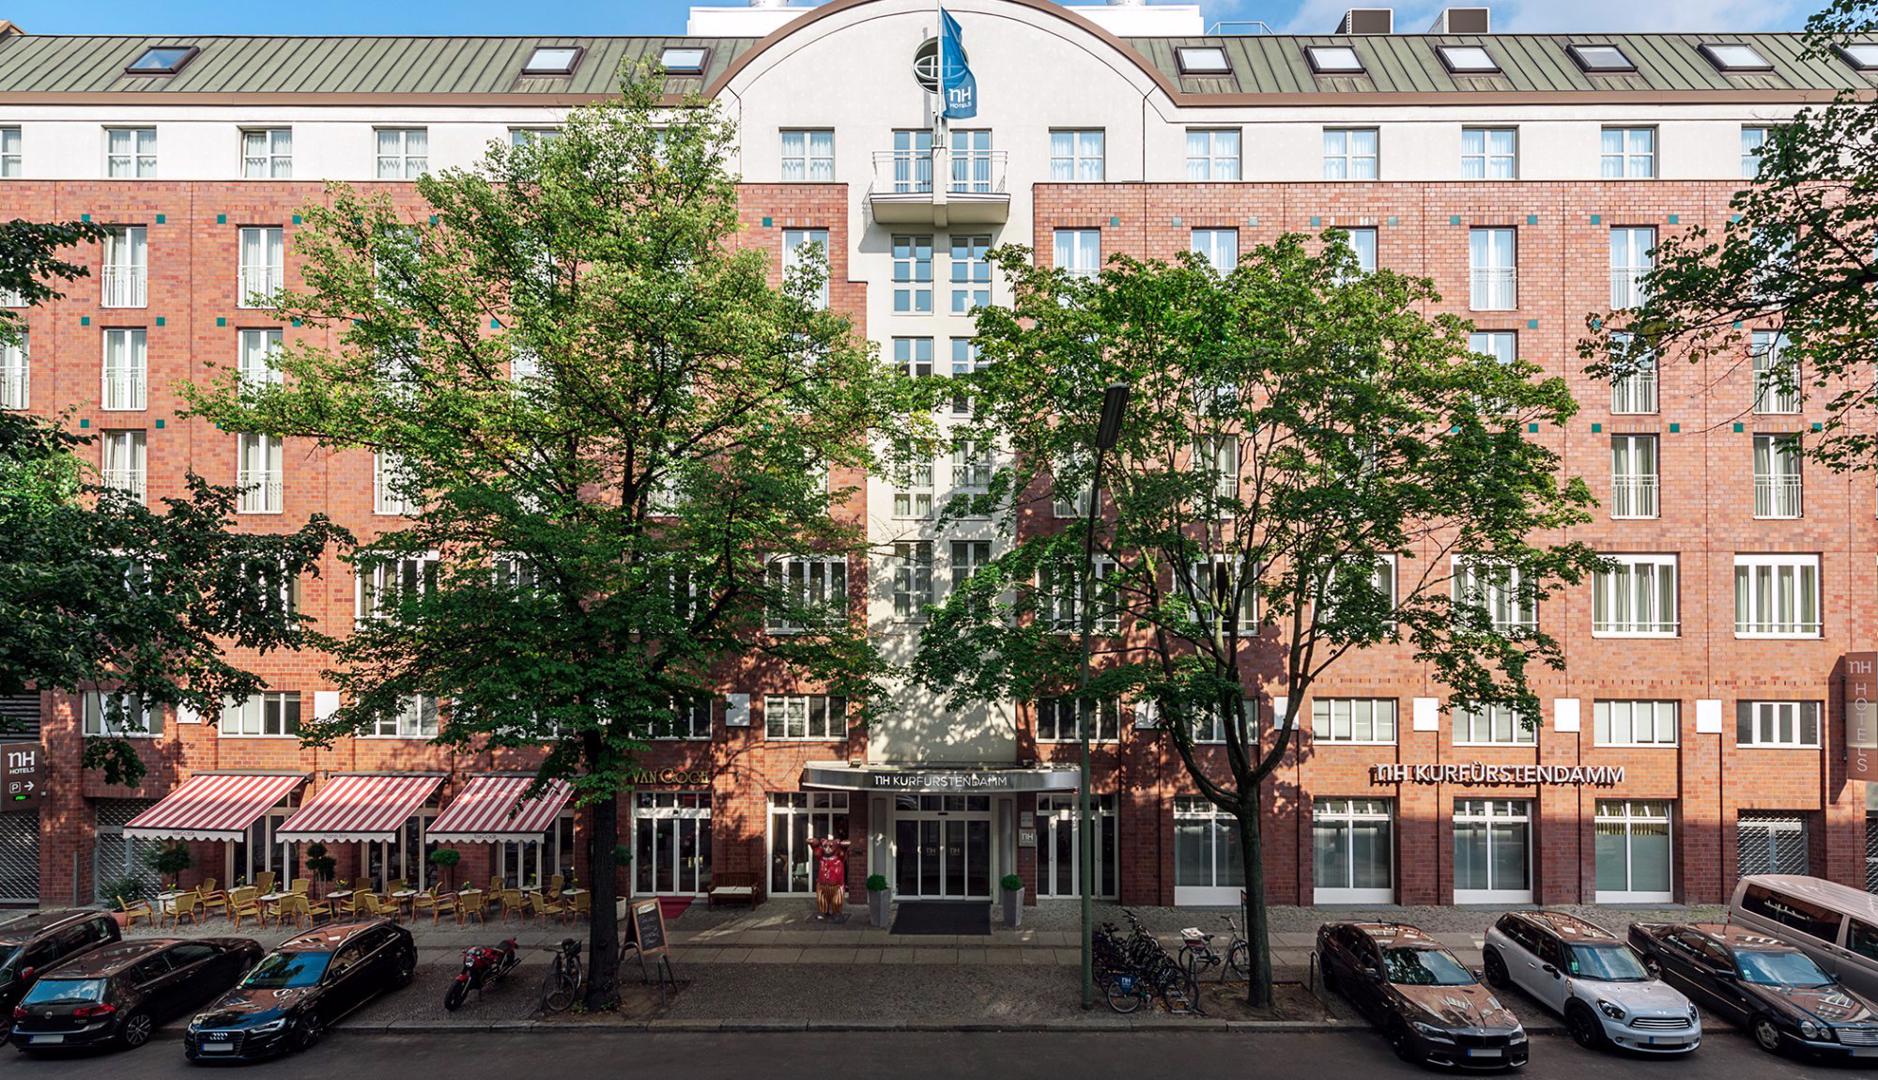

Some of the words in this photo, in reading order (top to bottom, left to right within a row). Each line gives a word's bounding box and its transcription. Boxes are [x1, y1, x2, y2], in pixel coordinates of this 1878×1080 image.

[1854, 682, 1868, 772] HOTELS
[9, 767, 35, 775] HOTELS
[632, 771, 657, 784] VAN
[1414, 761, 1626, 784] KURFÜRSTENDAMM
